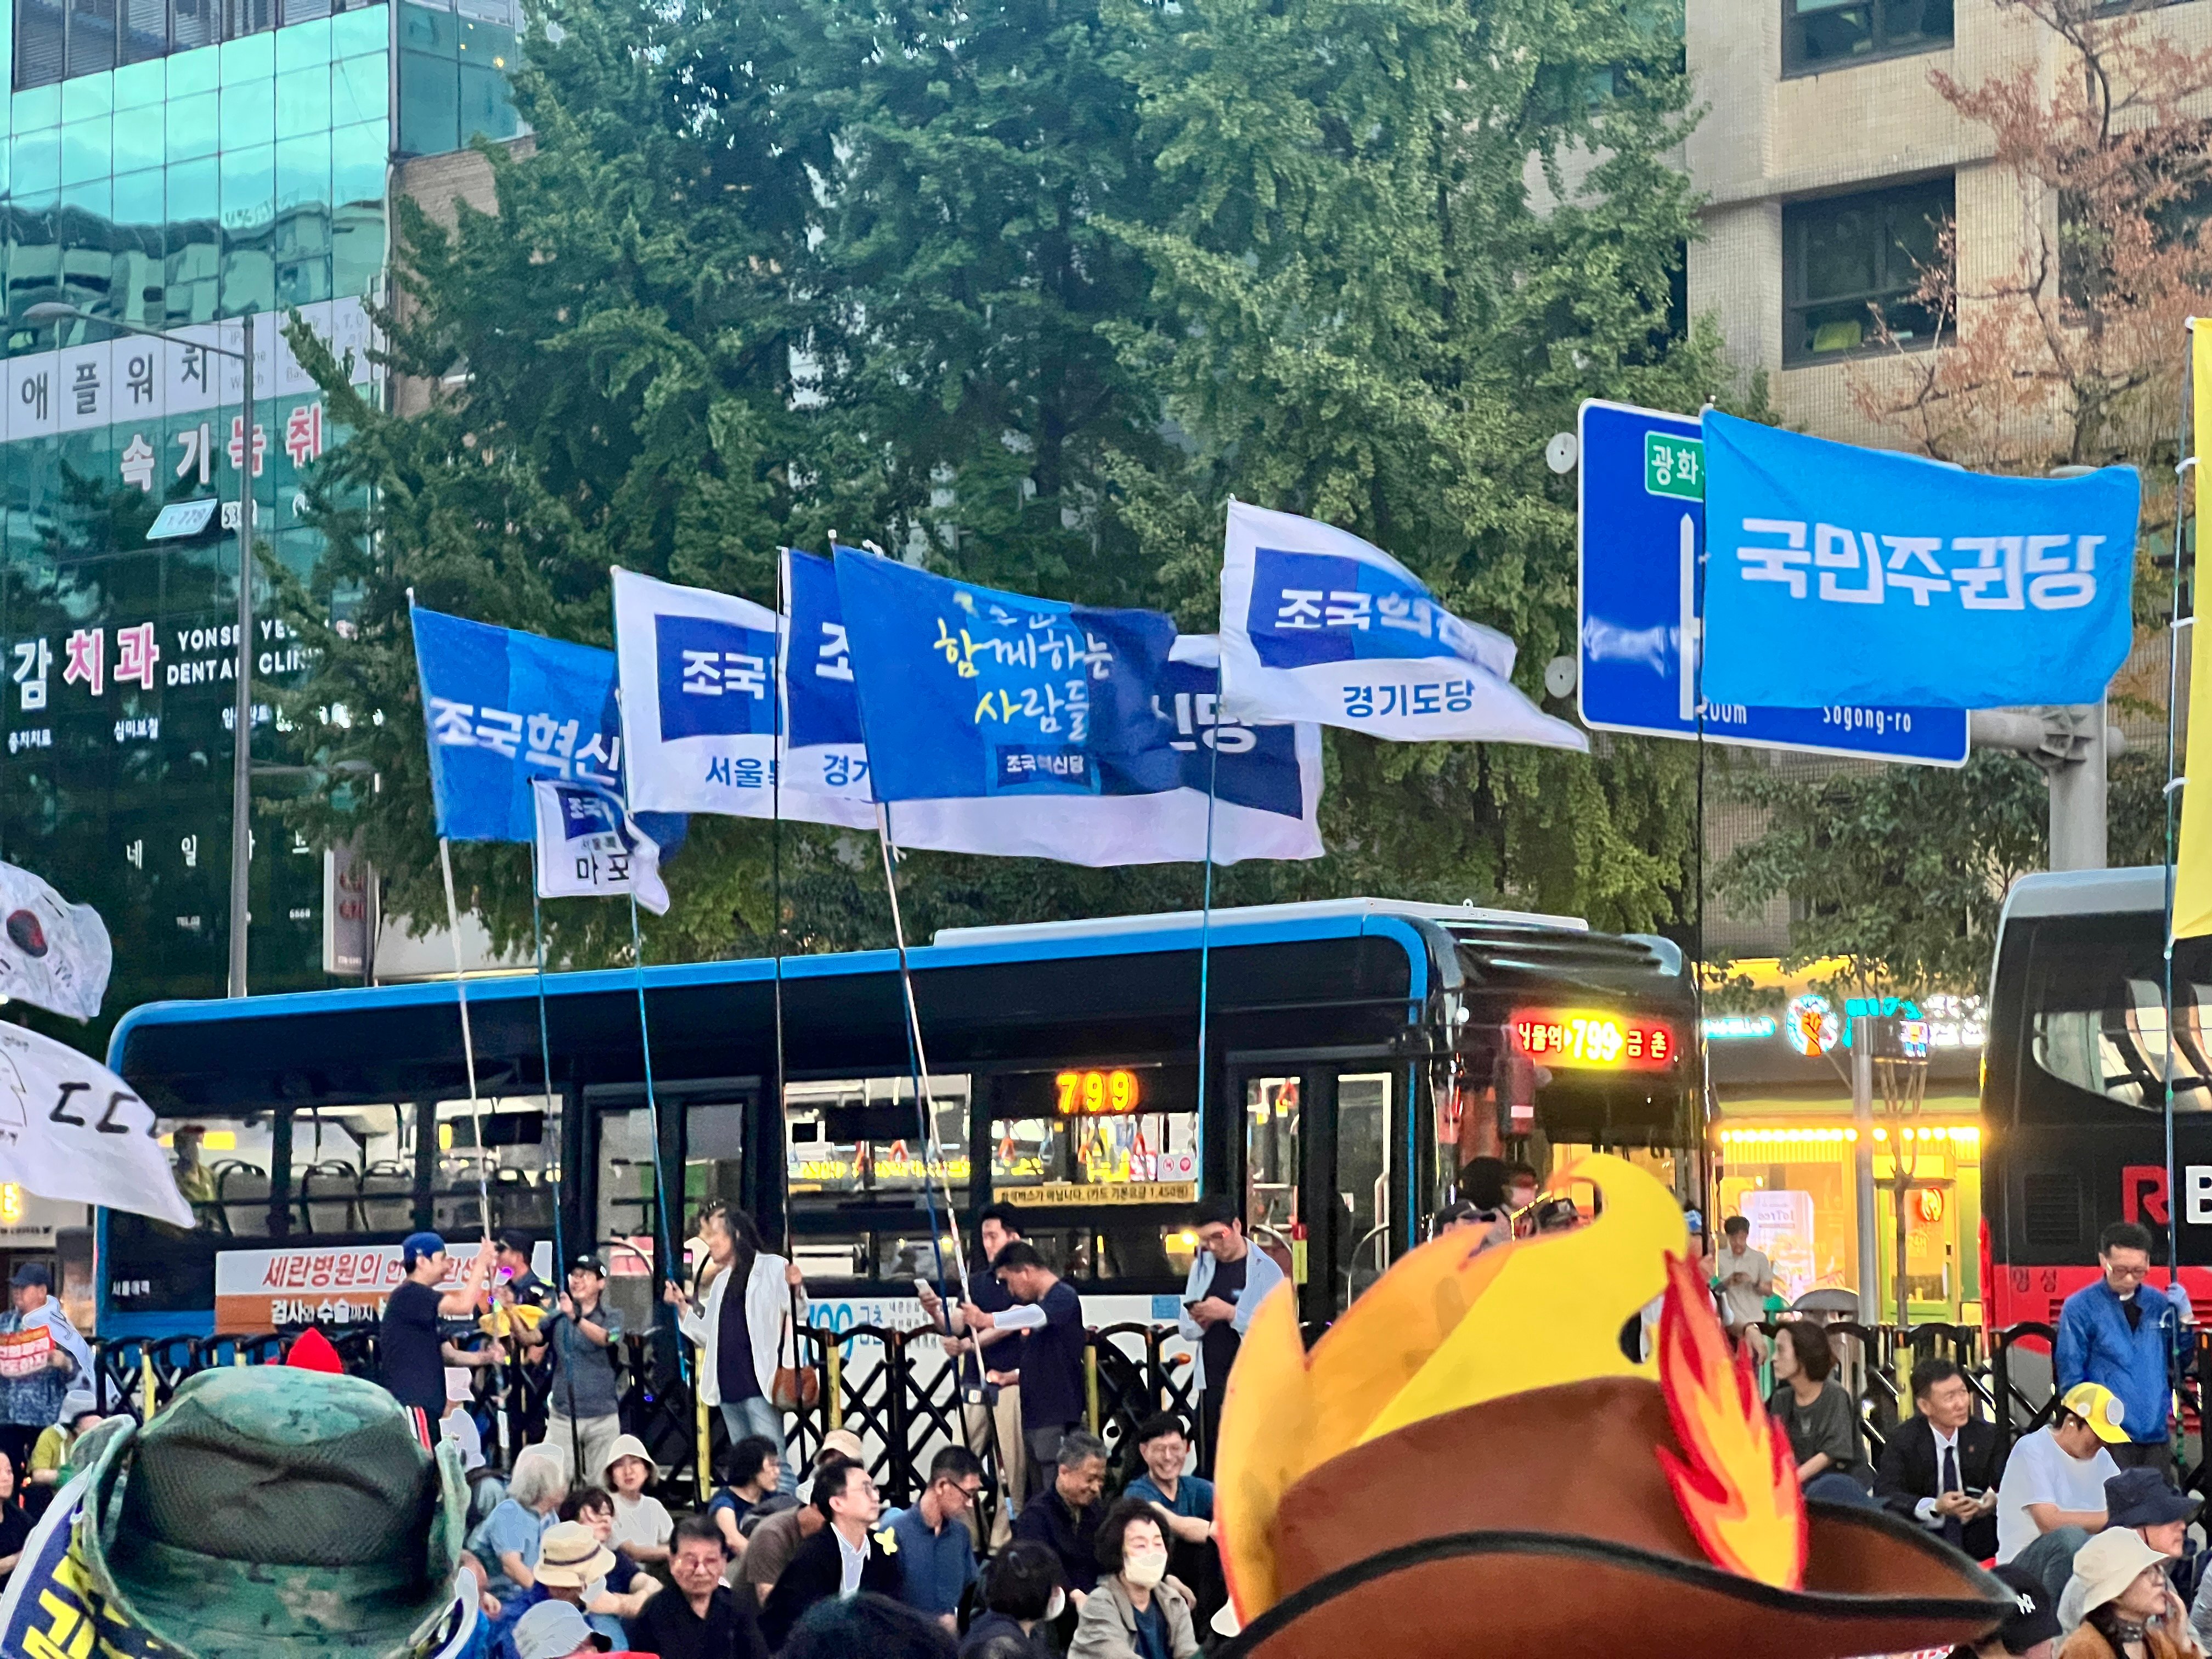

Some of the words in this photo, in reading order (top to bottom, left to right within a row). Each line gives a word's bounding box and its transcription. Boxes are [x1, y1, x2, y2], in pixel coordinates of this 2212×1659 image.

[1651, 444, 1705, 486] 광화
[1736, 517, 2107, 611] 국민주권당
[261, 619, 297, 640] YE
[933, 617, 1114, 679] 함께하는
[682, 650, 775, 701] 조국
[974, 682, 1091, 742] 사람들
[1342, 679, 1476, 718] 경기도당
[1823, 705, 1912, 735] Sogong-ro
[1572, 1019, 1618, 1061] 799
[1627, 1029, 1667, 1059] 금촌
[1057, 1071, 1131, 1114] 799
[262, 1252, 383, 1289] 세란병원의
